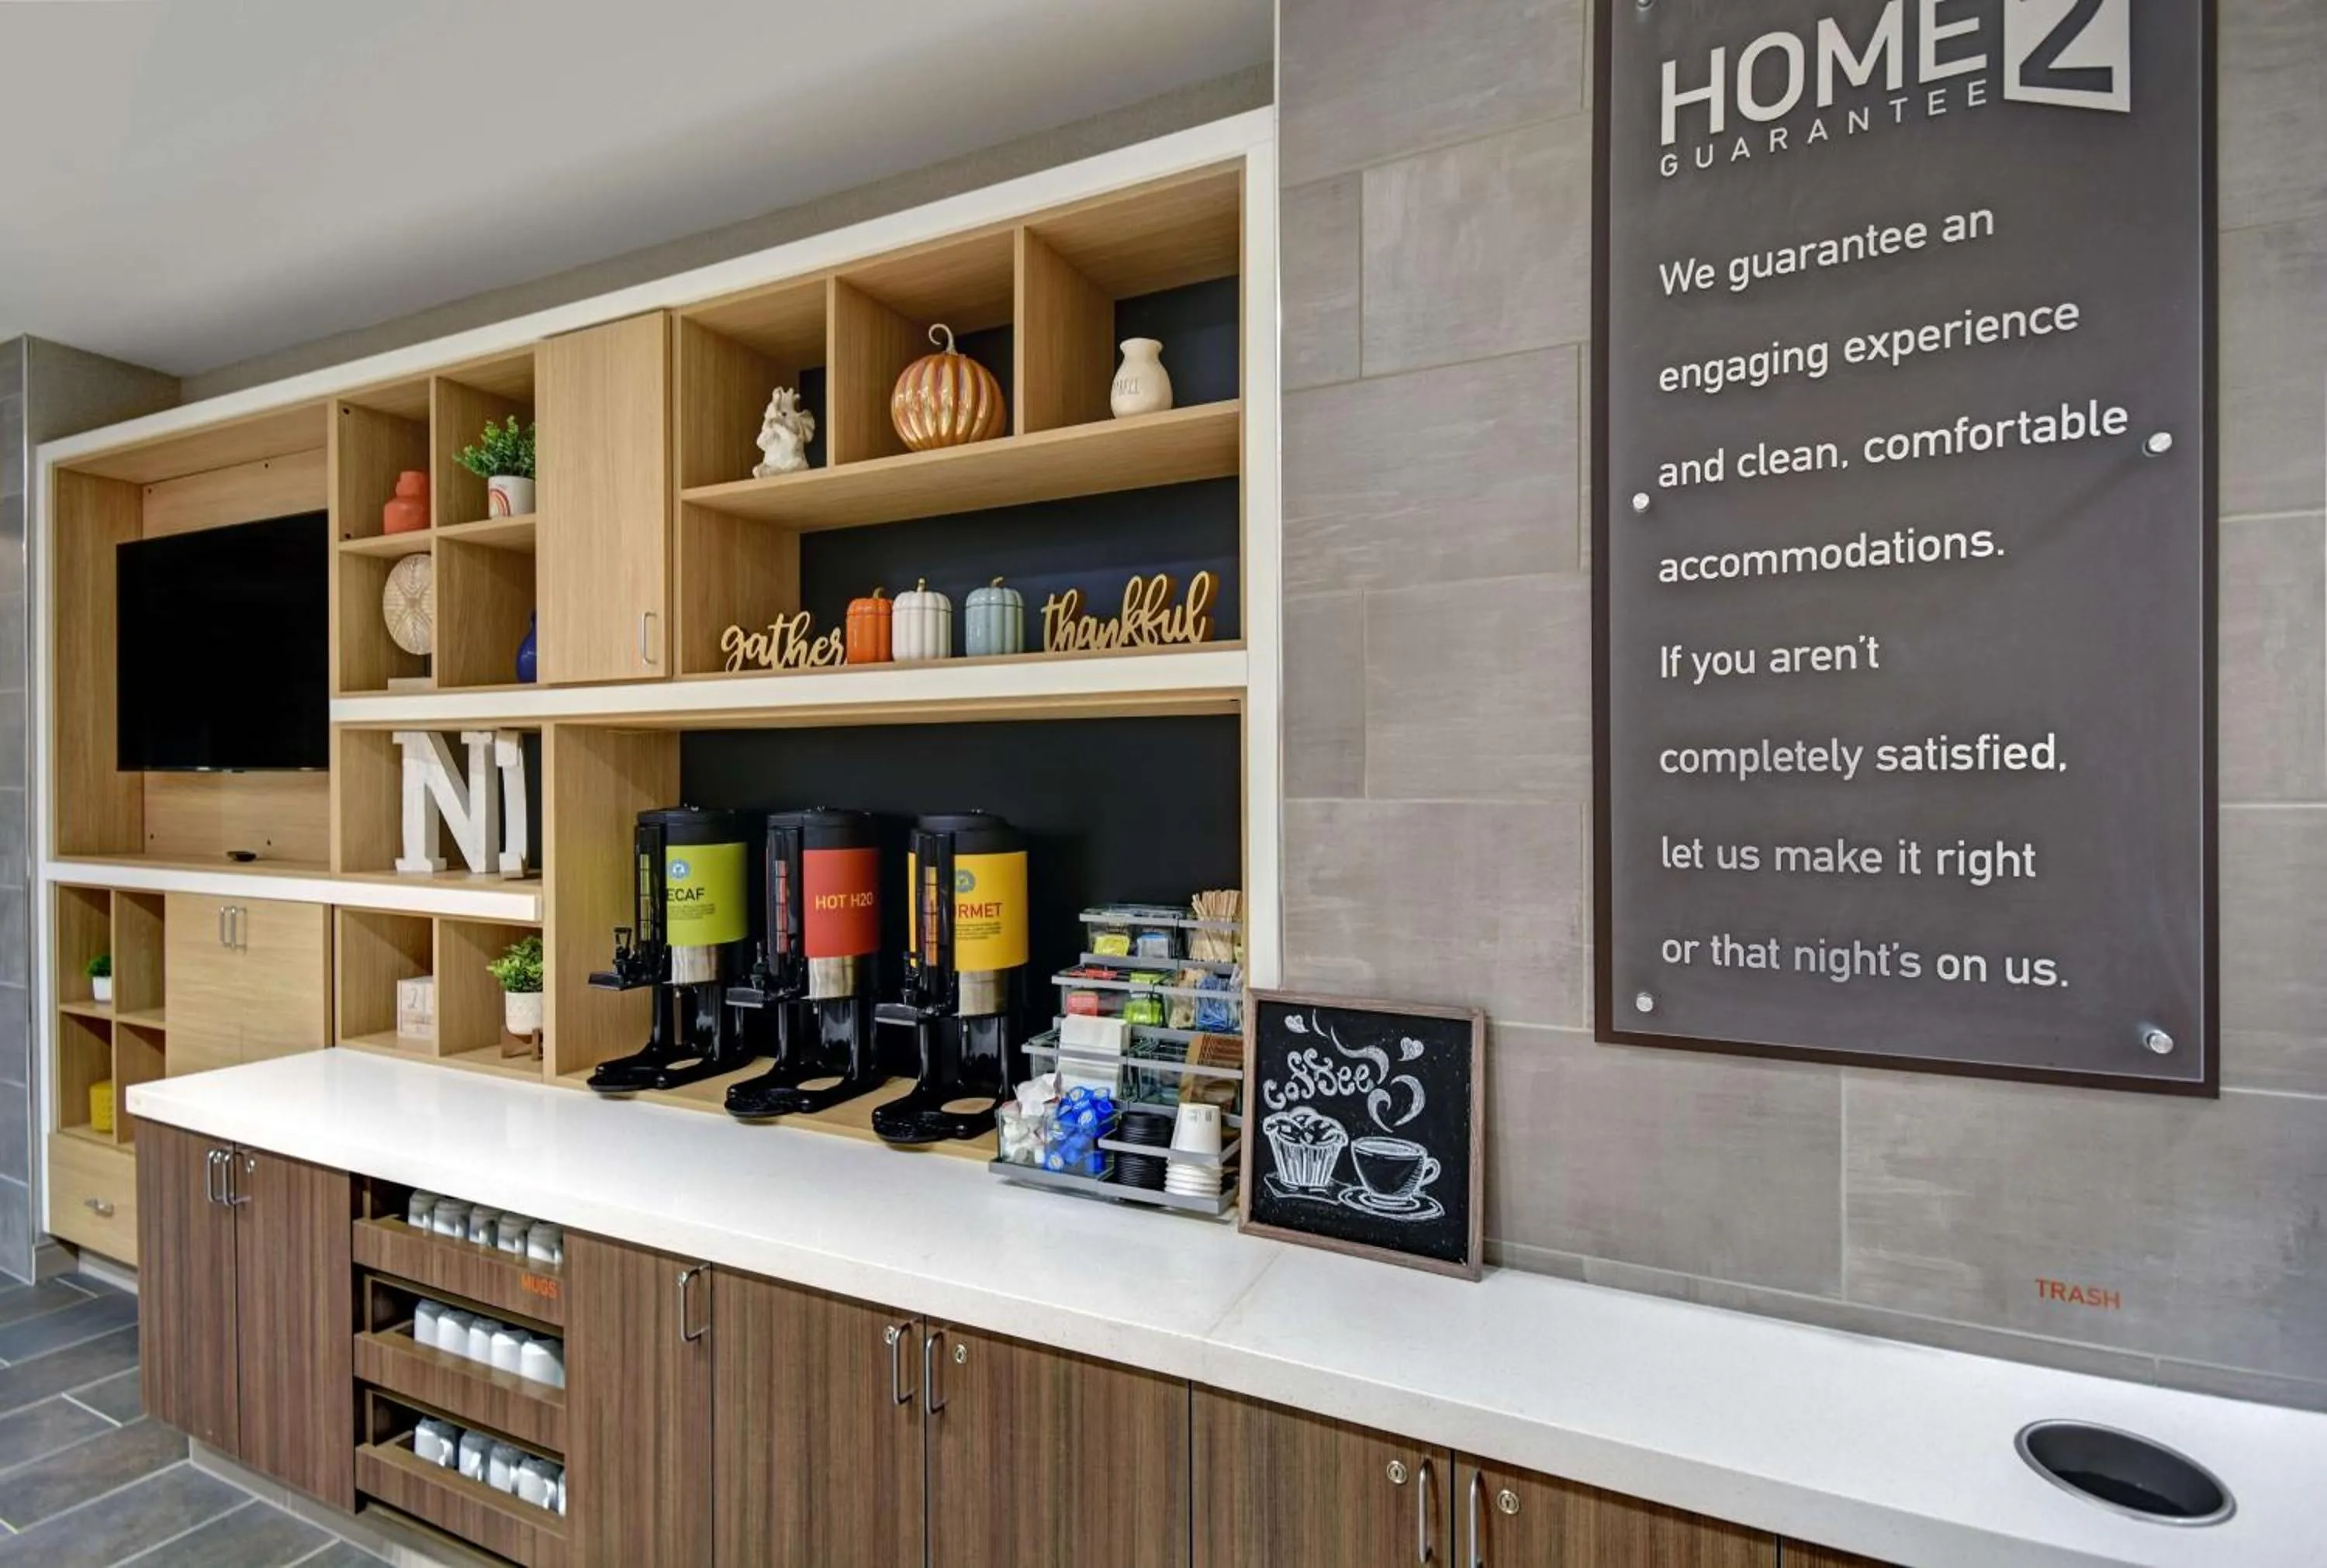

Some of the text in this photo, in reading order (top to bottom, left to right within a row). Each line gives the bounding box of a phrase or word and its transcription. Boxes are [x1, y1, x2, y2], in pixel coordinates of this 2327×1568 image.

[1660, 0, 1986, 146] HOME
[1659, 79, 1986, 177] GUARANTEE
[1658, 209, 1993, 295] We guarantee an
[1658, 302, 2080, 393] engaging experience
[1658, 399, 2128, 488] and clean, comfortable
[1658, 527, 2005, 583] accommodations.
[1041, 571, 1210, 653] thankful
[721, 610, 848, 672] gather
[1660, 634, 1879, 685] If you aren't
[1658, 732, 2067, 782] completely satisfied,
[1661, 835, 2036, 886] let us make it right
[666, 887, 705, 901] ECAF
[815, 894, 847, 910] HOT
[956, 902, 1003, 918] RMET
[1661, 934, 2068, 987] or that night's on us.
[2035, 1278, 2121, 1310] TRASH
